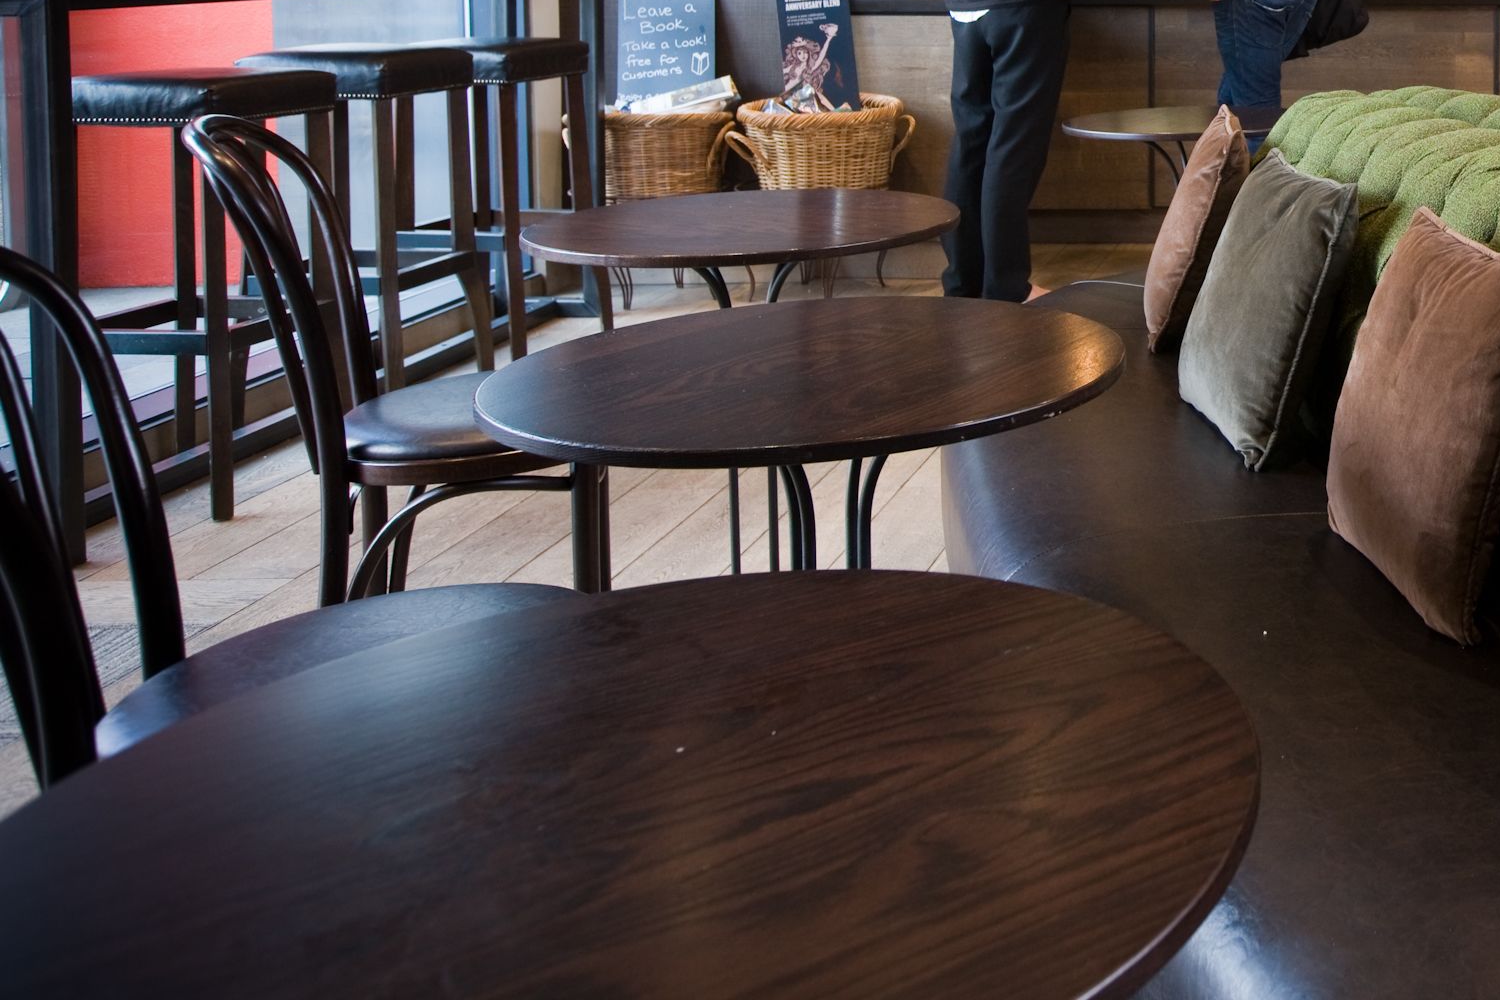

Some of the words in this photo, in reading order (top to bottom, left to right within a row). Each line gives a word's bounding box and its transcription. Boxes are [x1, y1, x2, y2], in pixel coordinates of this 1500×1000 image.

[684, 3, 696, 13] a
[786, 0, 822, 11] ANNIVERSARY
[640, 18, 688, 34] Book,
[622, 40, 656, 52] Take
[625, 54, 651, 68] free
[660, 54, 679, 66] for
